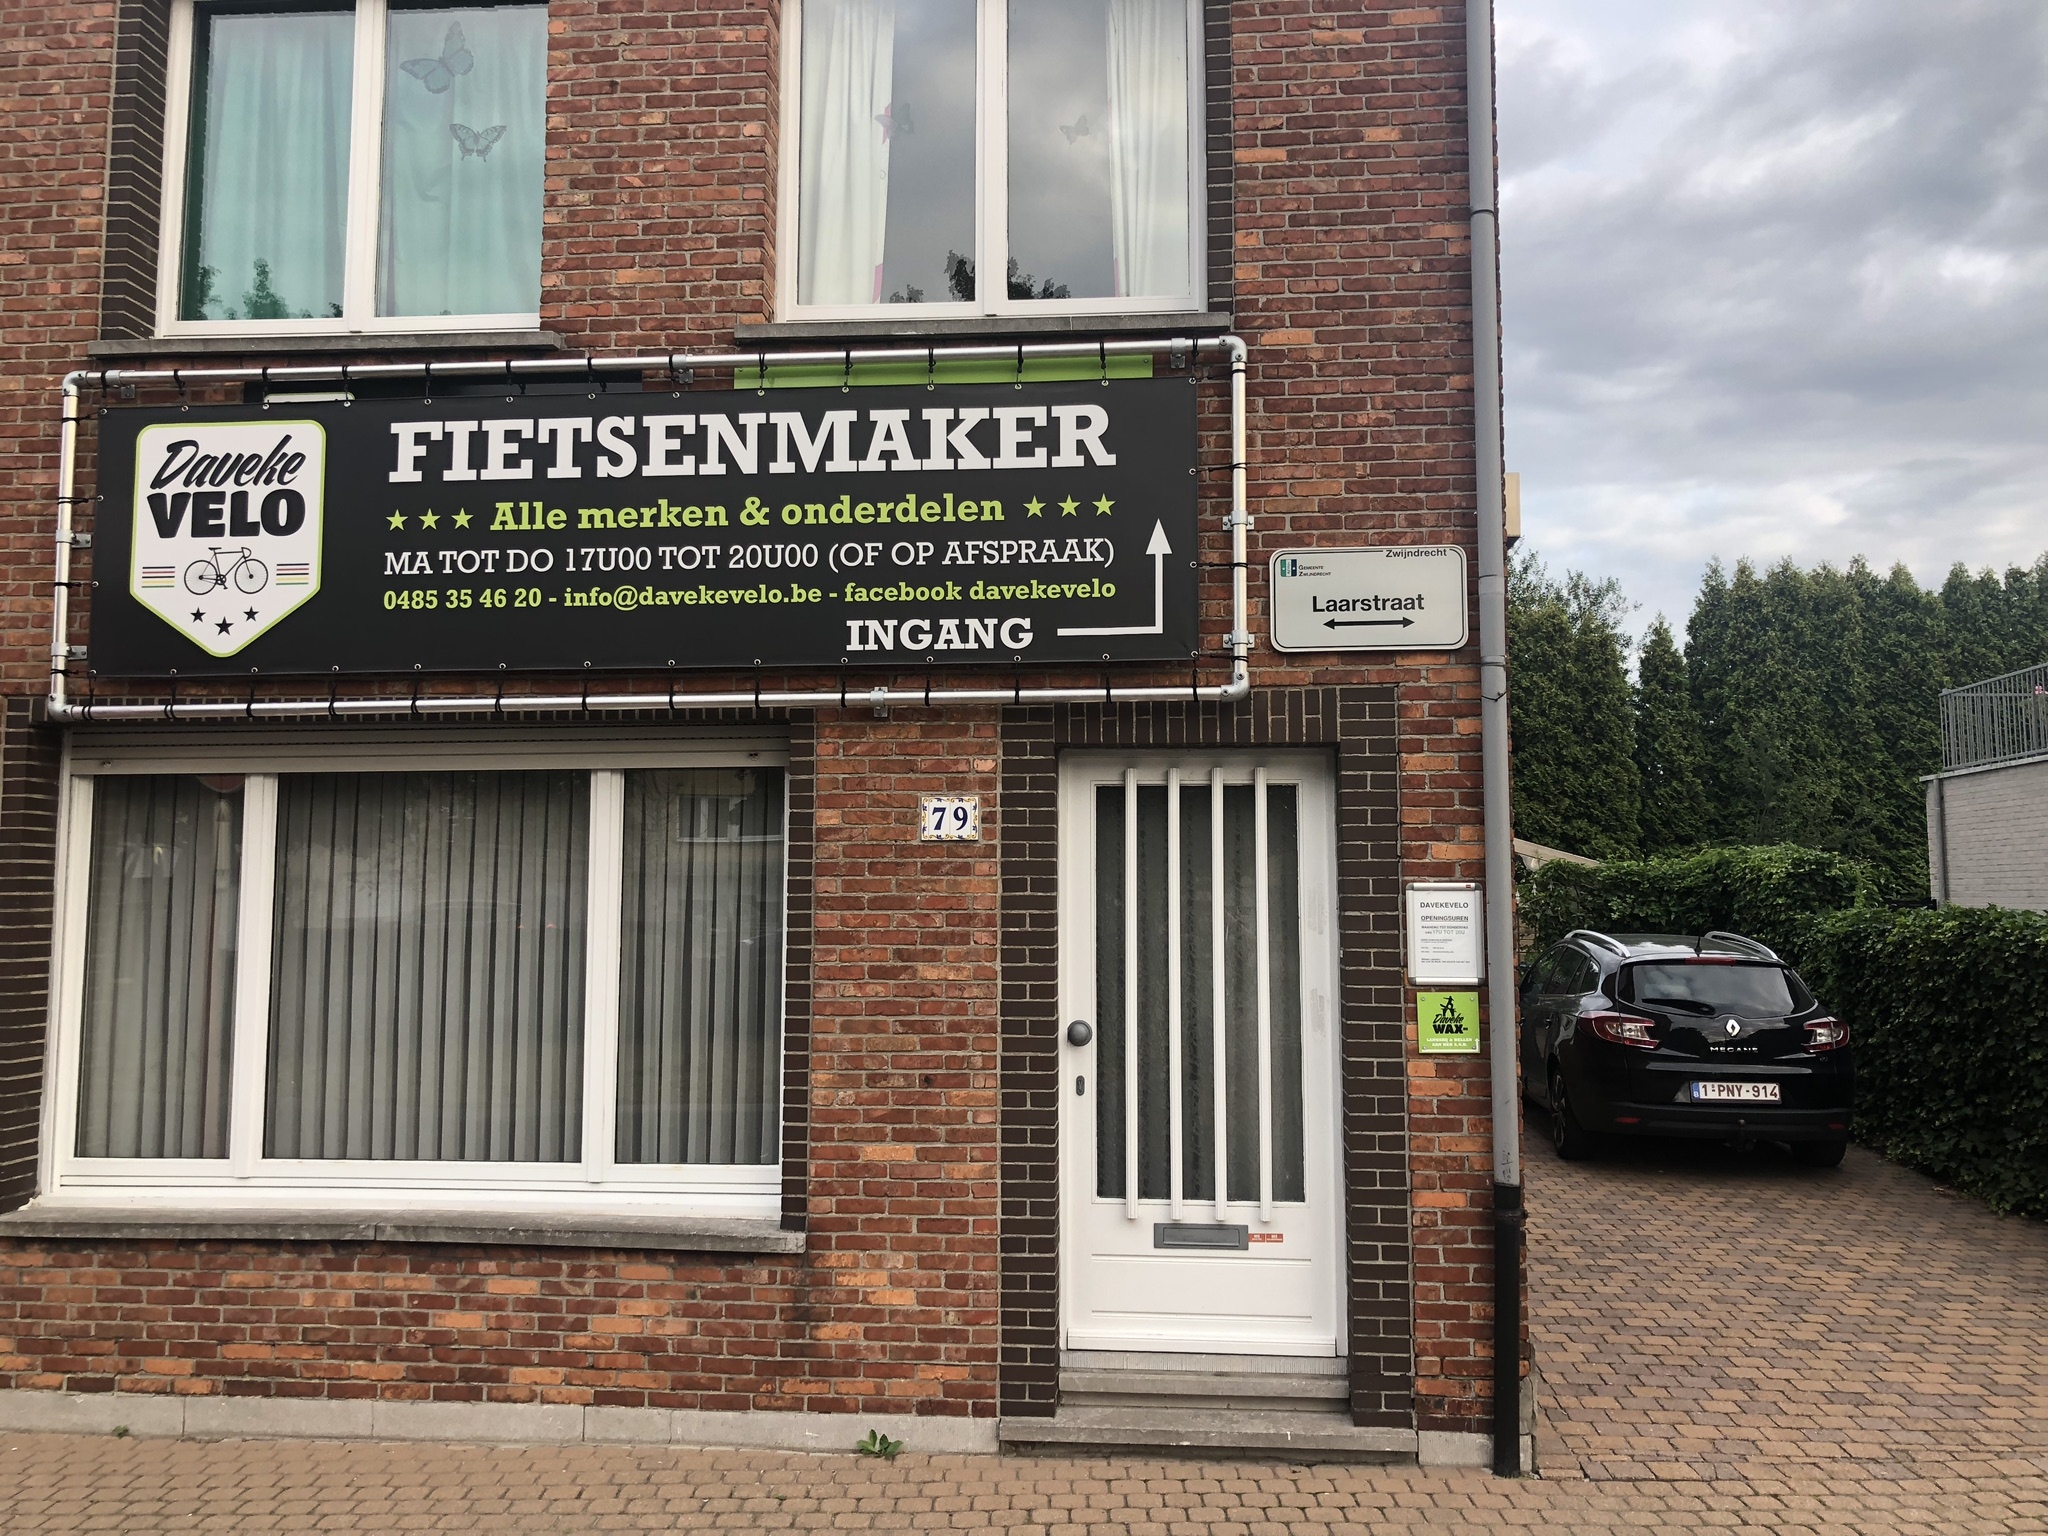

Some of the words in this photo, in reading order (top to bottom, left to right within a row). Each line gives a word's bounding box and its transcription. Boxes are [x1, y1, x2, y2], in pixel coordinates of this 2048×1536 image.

[389, 403, 1116, 483] FIETSENMAKER
[149, 434, 306, 490] Daveke
[146, 488, 306, 539] VELO
[489, 501, 568, 531] Alle
[577, 499, 729, 529] merken
[739, 496, 770, 526] &
[781, 493, 1005, 525] onderdelen
[384, 551, 434, 575] MA
[438, 550, 500, 574] TOT
[505, 549, 554, 573] DO
[565, 547, 652, 572] 17U00
[658, 545, 721, 570] TOT
[728, 544, 819, 569] 20U00
[828, 543, 883, 574] (OF
[891, 541, 935, 566] OP
[941, 537, 1115, 569] AFSPRAAK)
[1385, 548, 1448, 559] Zwijndrecht
[383, 590, 438, 610] 0485
[445, 589, 473, 609] 35
[479, 589, 507, 608] 46
[514, 588, 542, 608] 20
[564, 583, 822, 611] info@davekevelo.be
[844, 581, 962, 602] facebook
[969, 578, 1116, 600] davekevelo
[1312, 593, 1425, 613] Laarstraat
[846, 618, 1034, 651] INGANG
[932, 806, 968, 831] 79
[1433, 1013, 1464, 1024] Daveke
